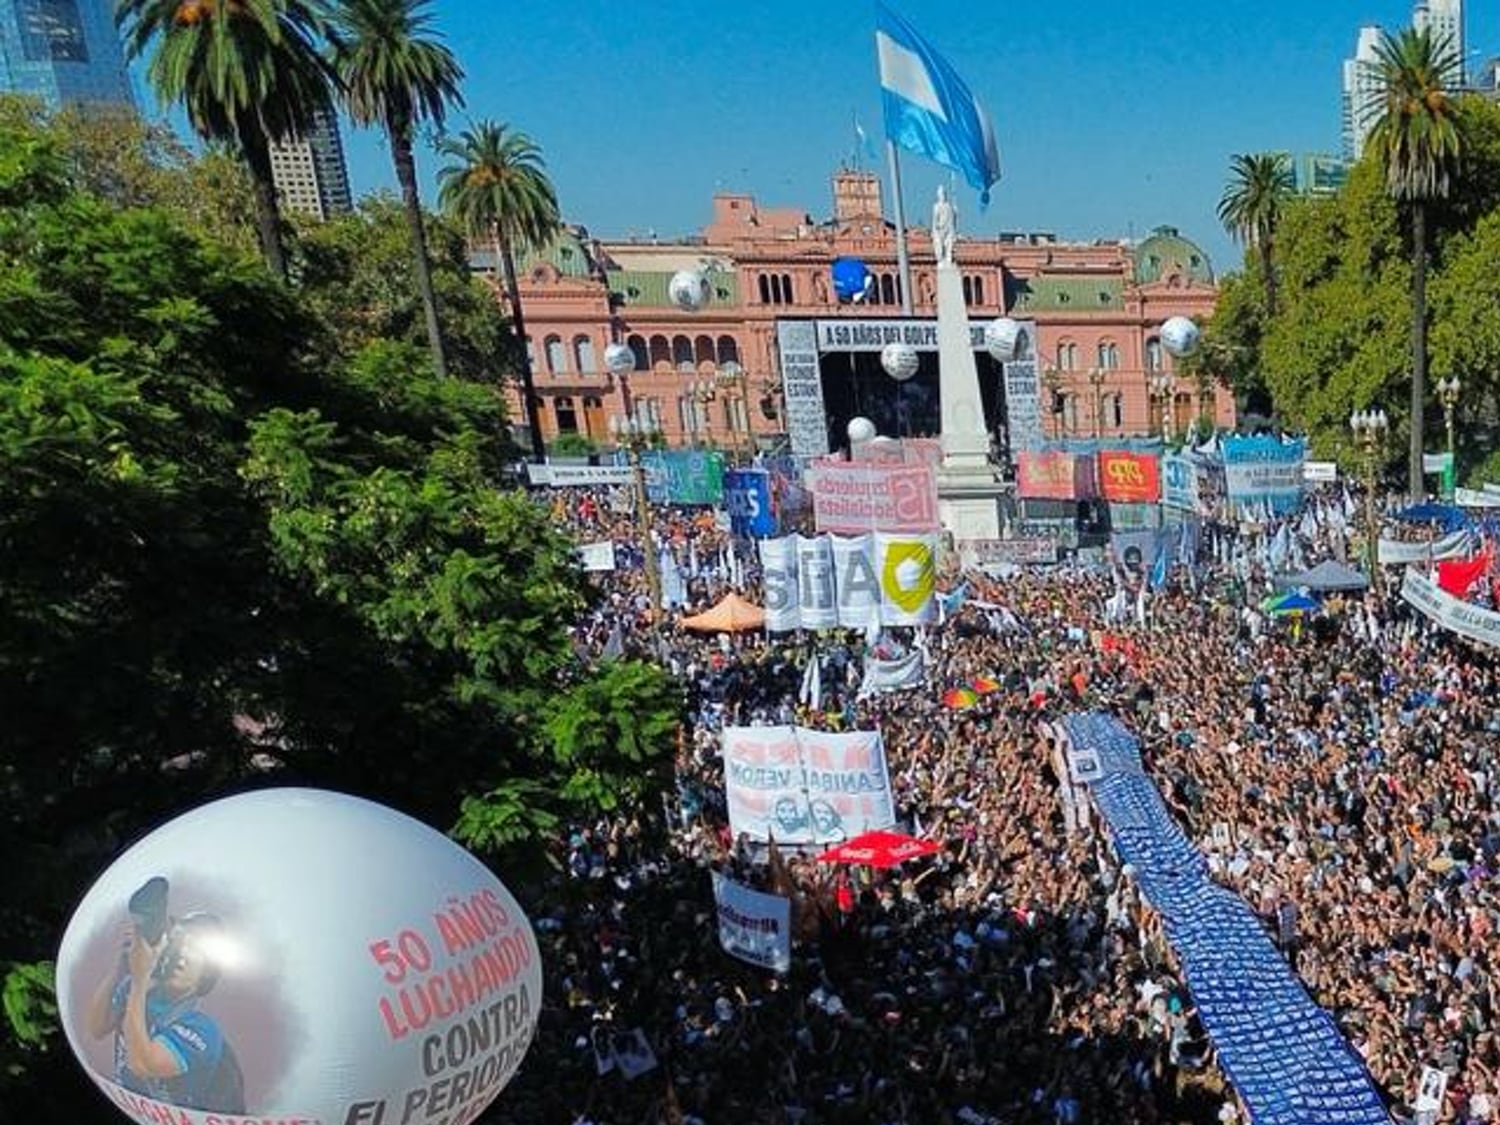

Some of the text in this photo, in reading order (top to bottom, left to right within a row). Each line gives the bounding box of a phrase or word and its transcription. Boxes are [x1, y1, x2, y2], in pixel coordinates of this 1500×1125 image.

[826, 323, 938, 346] A 50 AÑOS DEL GOLPE
[371, 887, 514, 983] 50 AÑOS
[378, 931, 533, 1040] LUCHANDO
[421, 983, 532, 1078] CONTRA
